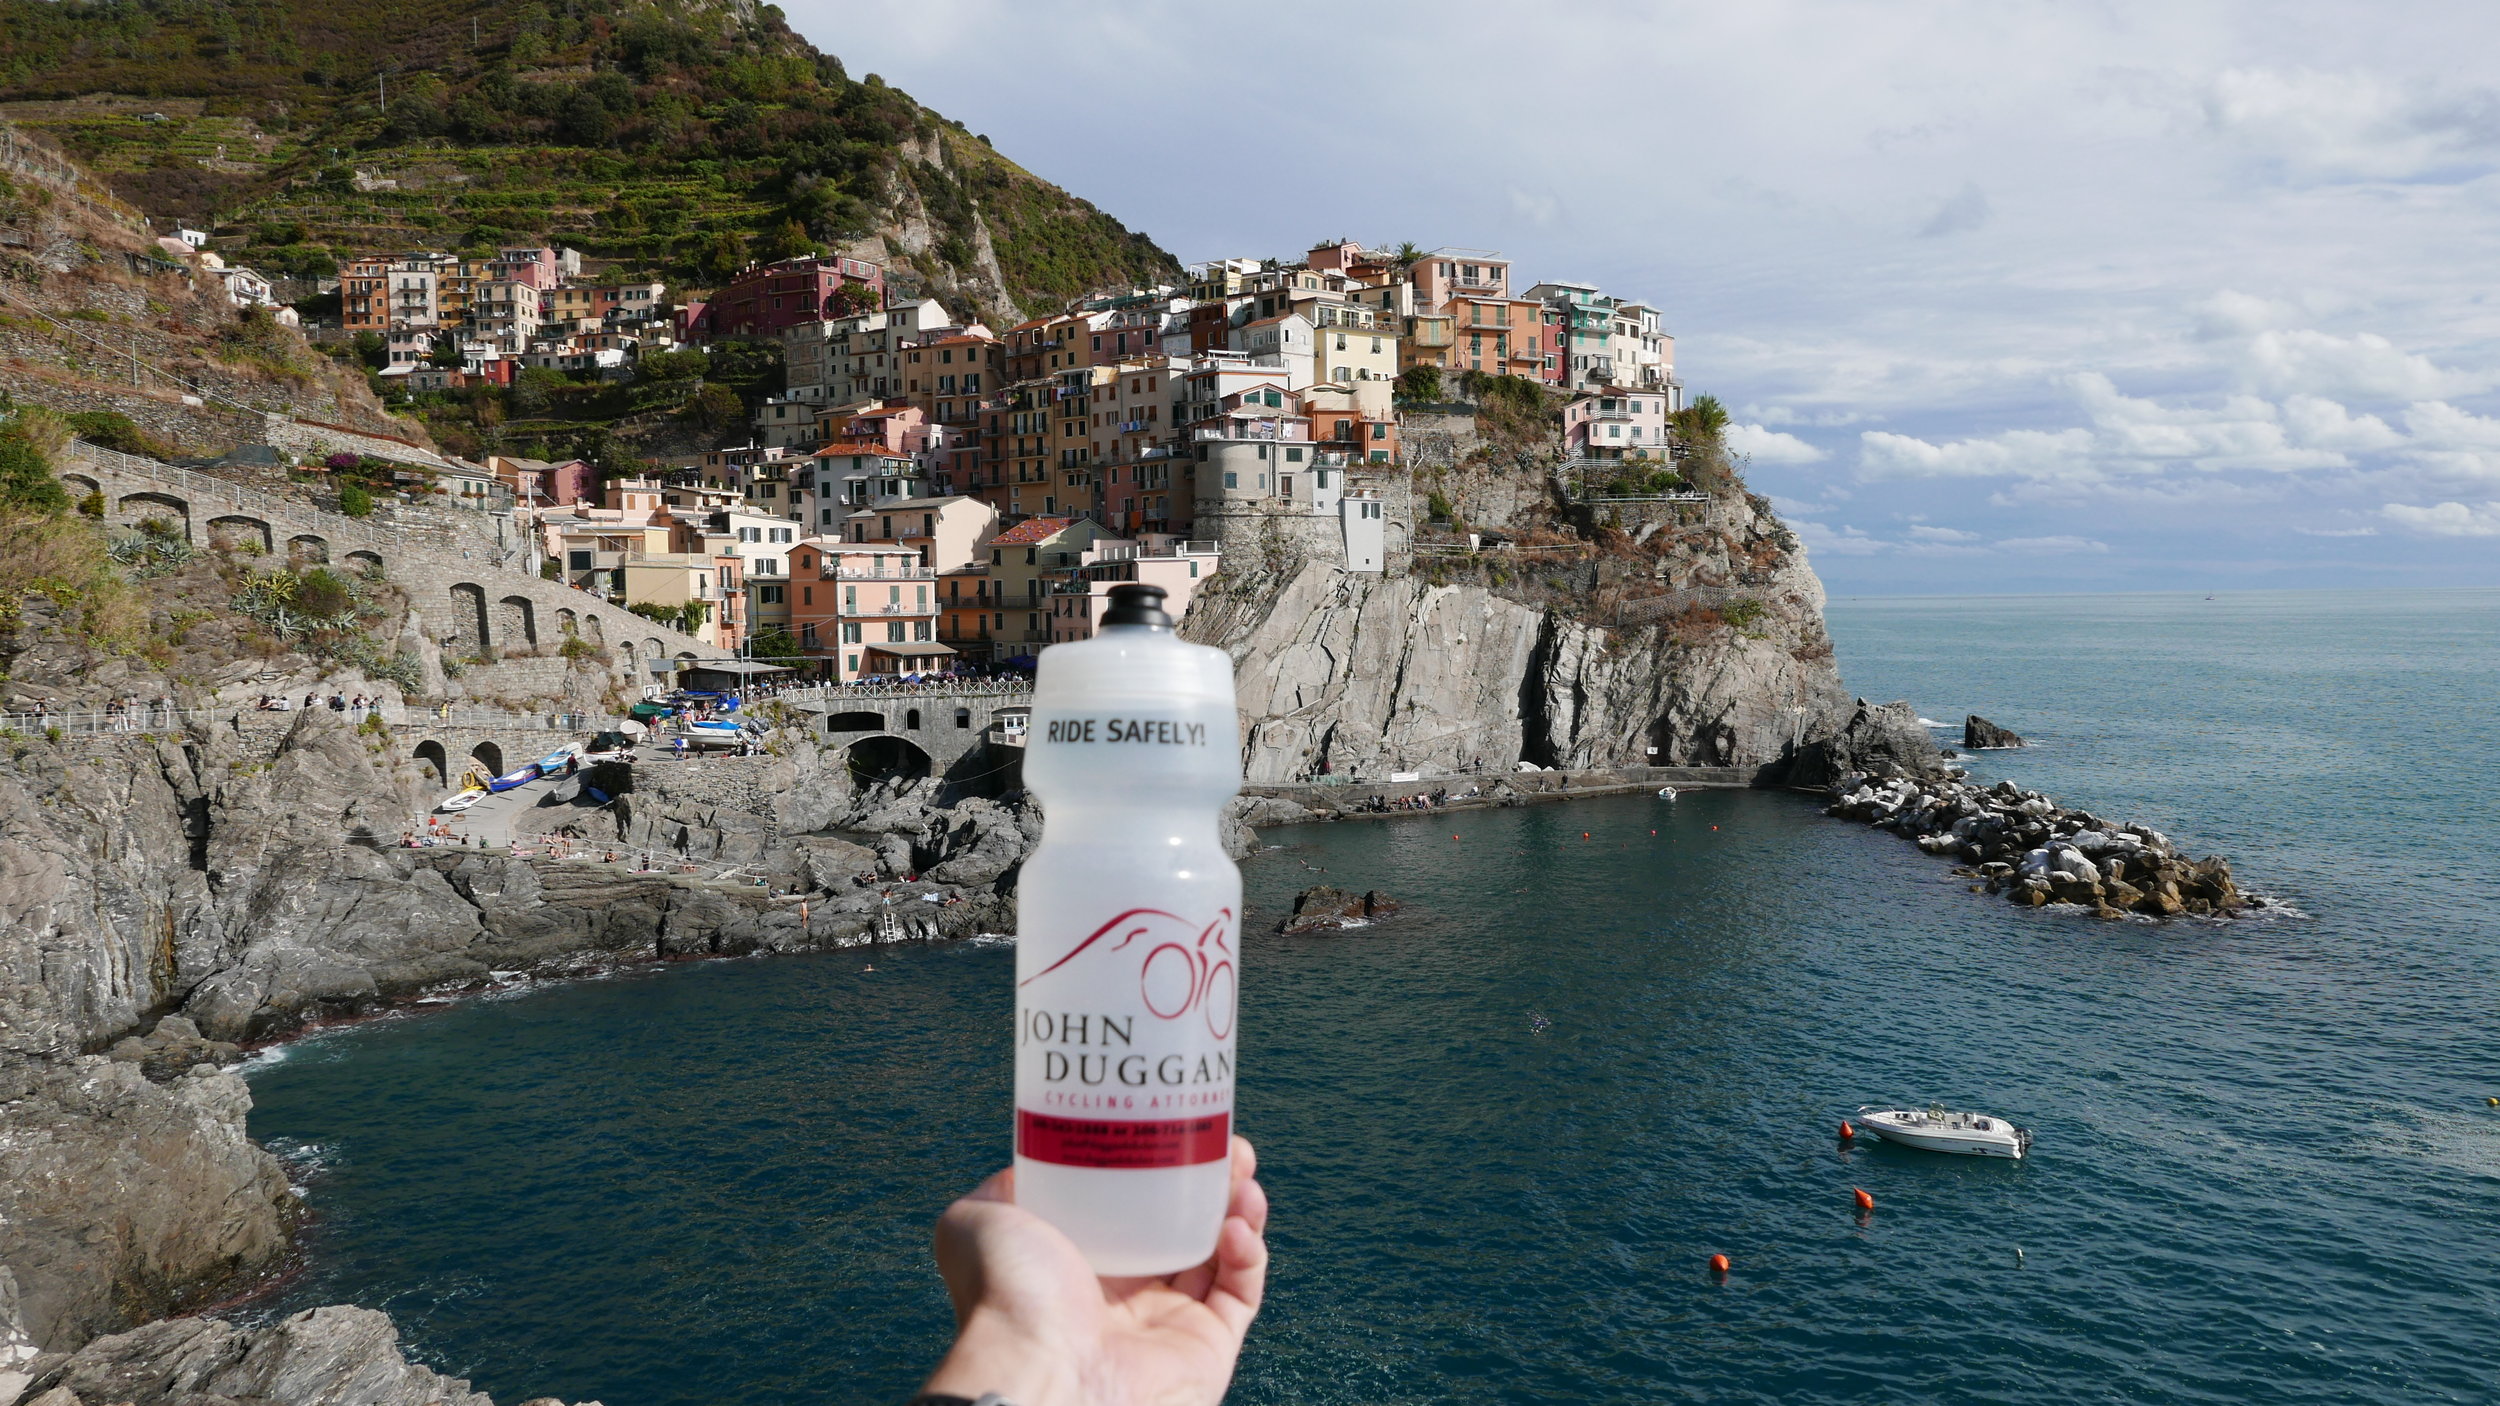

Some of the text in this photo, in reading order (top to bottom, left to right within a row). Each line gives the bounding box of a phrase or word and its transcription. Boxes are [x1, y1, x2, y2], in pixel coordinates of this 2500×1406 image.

[1048, 718, 1206, 747] RIDE SAFELY!
[1022, 1008, 1133, 1047] JOHN
[1044, 1049, 1232, 1087] DUGGAN
[1045, 1090, 1134, 1110] CYCLING
